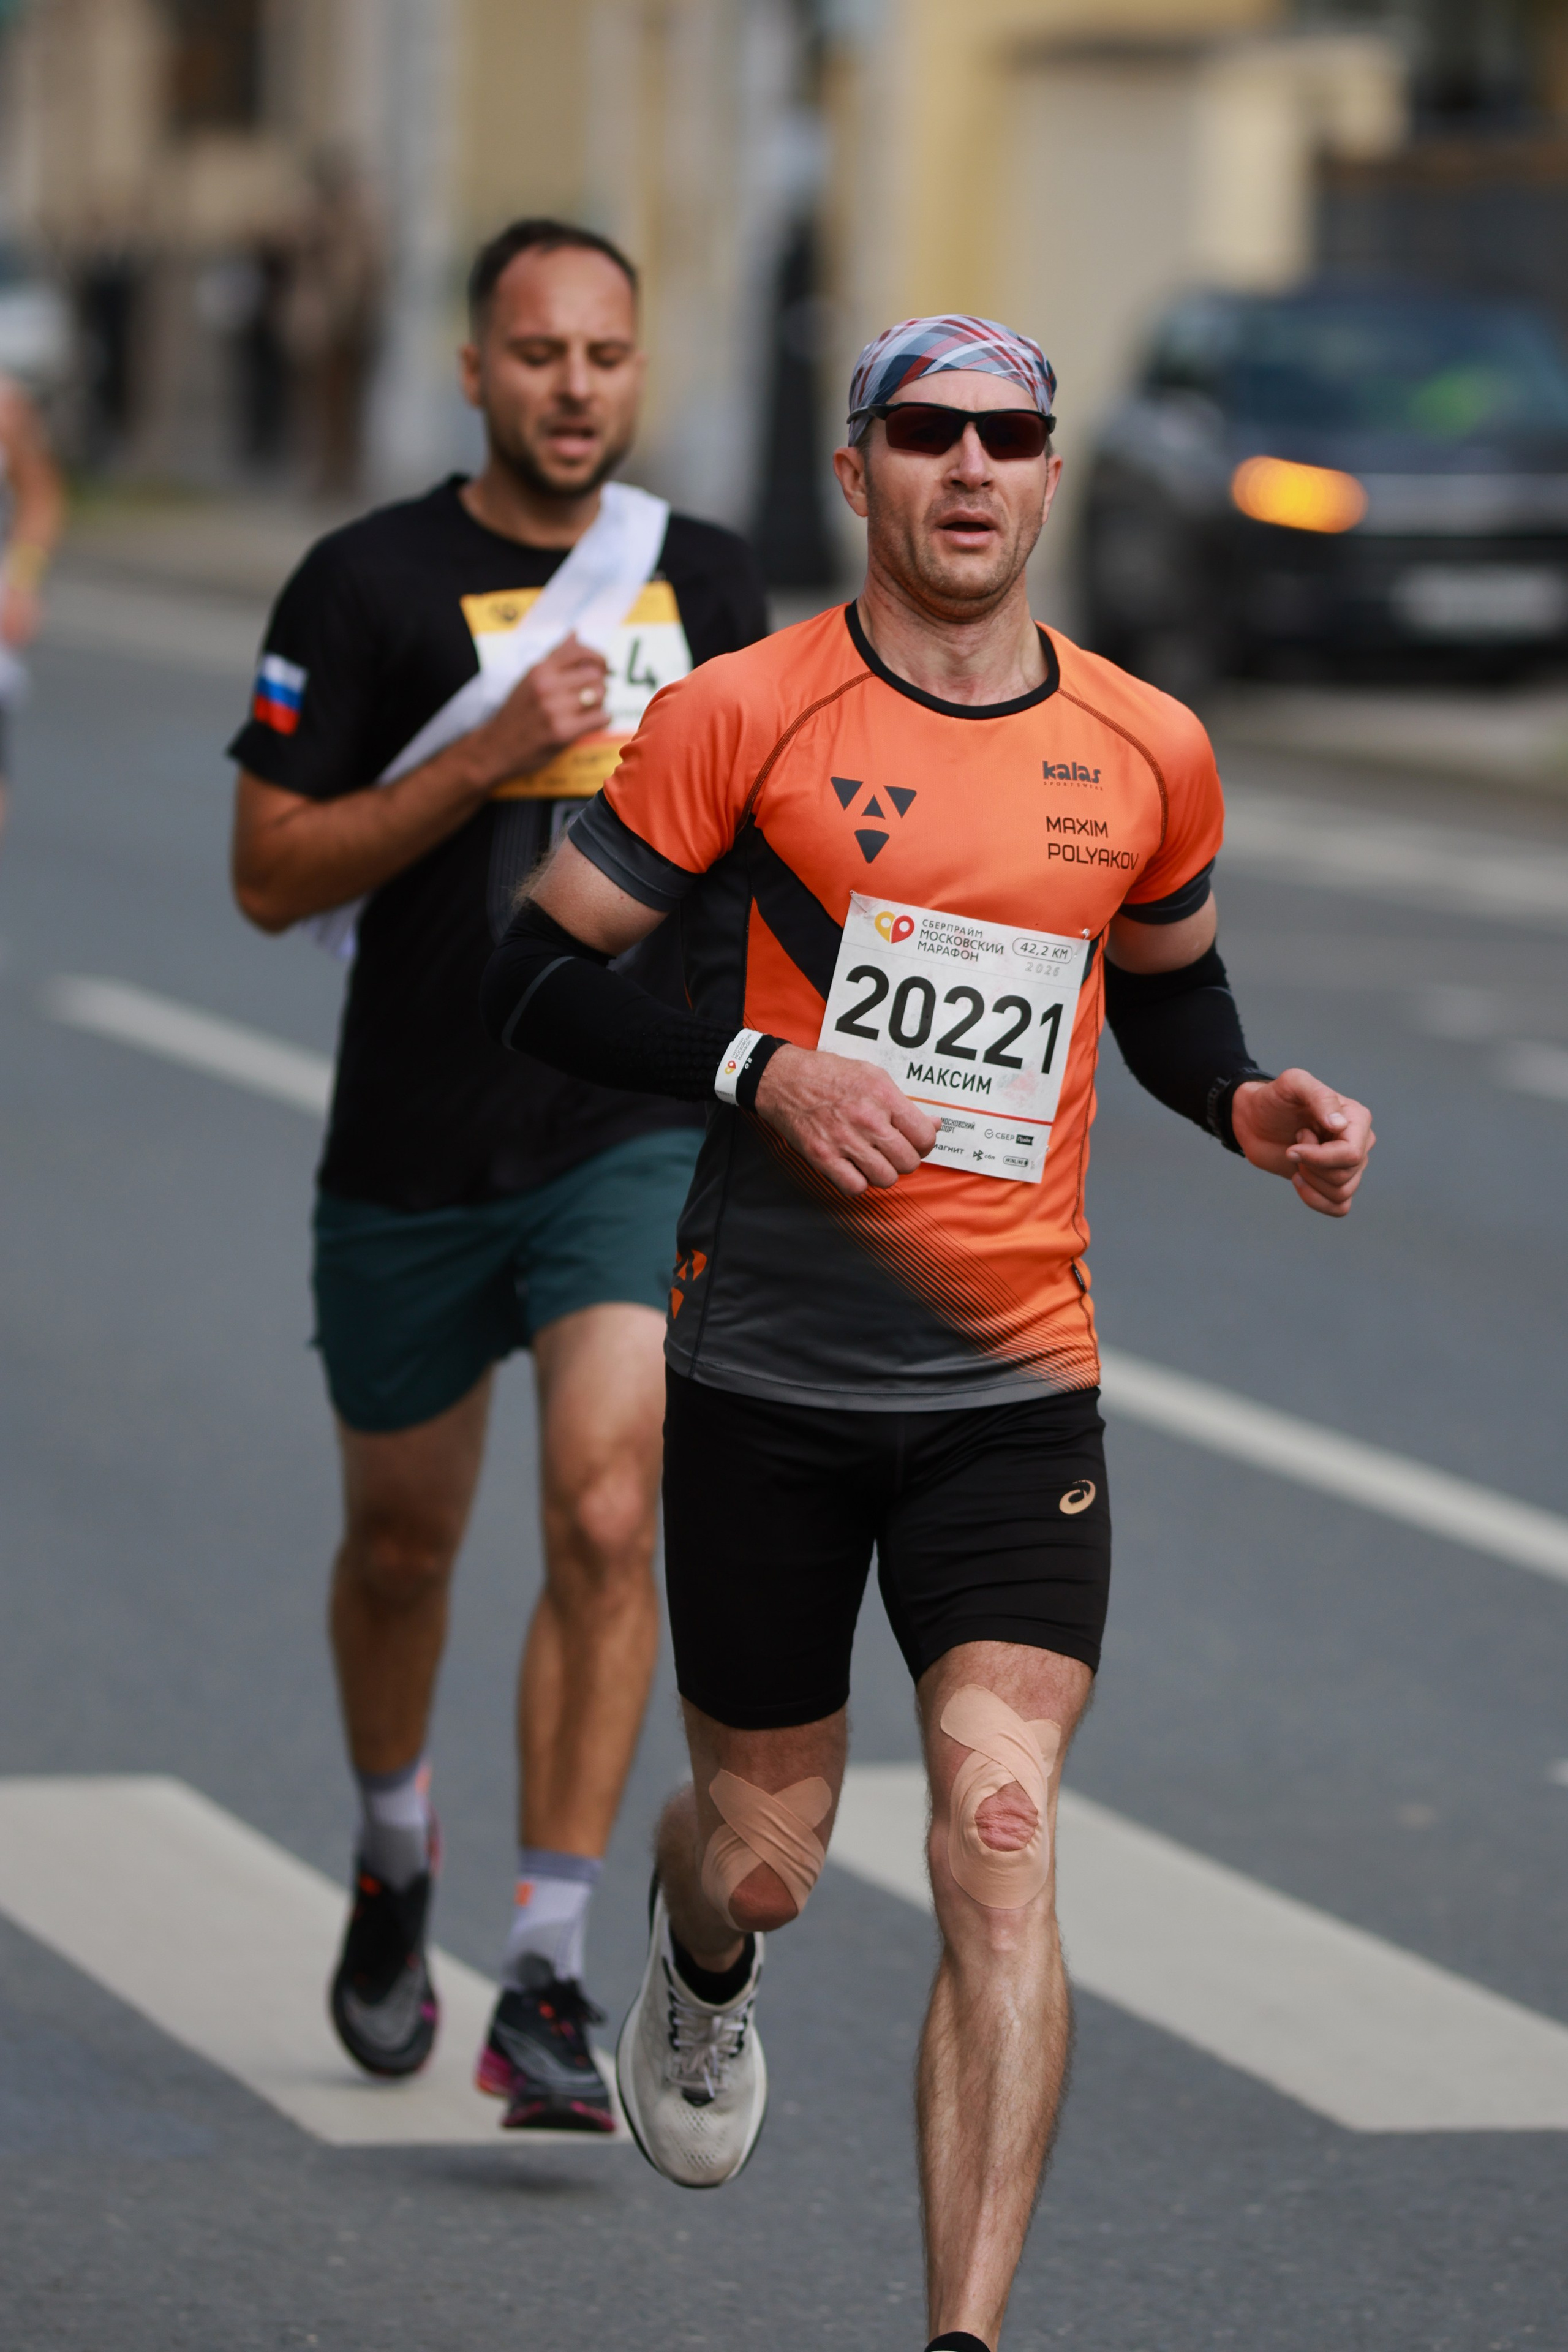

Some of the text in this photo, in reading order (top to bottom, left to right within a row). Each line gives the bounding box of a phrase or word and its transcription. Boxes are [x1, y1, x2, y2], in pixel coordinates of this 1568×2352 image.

[1042, 761, 1101, 783] kalas
[1046, 816, 1108, 838] MAXIM
[1047, 842, 1139, 870] POLYAKOV
[922, 919, 982, 938] СБЕРПРАЙМ
[917, 941, 979, 962] МАРАФОН
[919, 929, 1004, 954] МОСКОВСКИЙ
[1020, 942, 1047, 956] 42,2
[835, 964, 1063, 1074] 20221
[907, 1061, 992, 1095] МАКСИМ
[995, 1132, 1015, 1141] СБЕР
